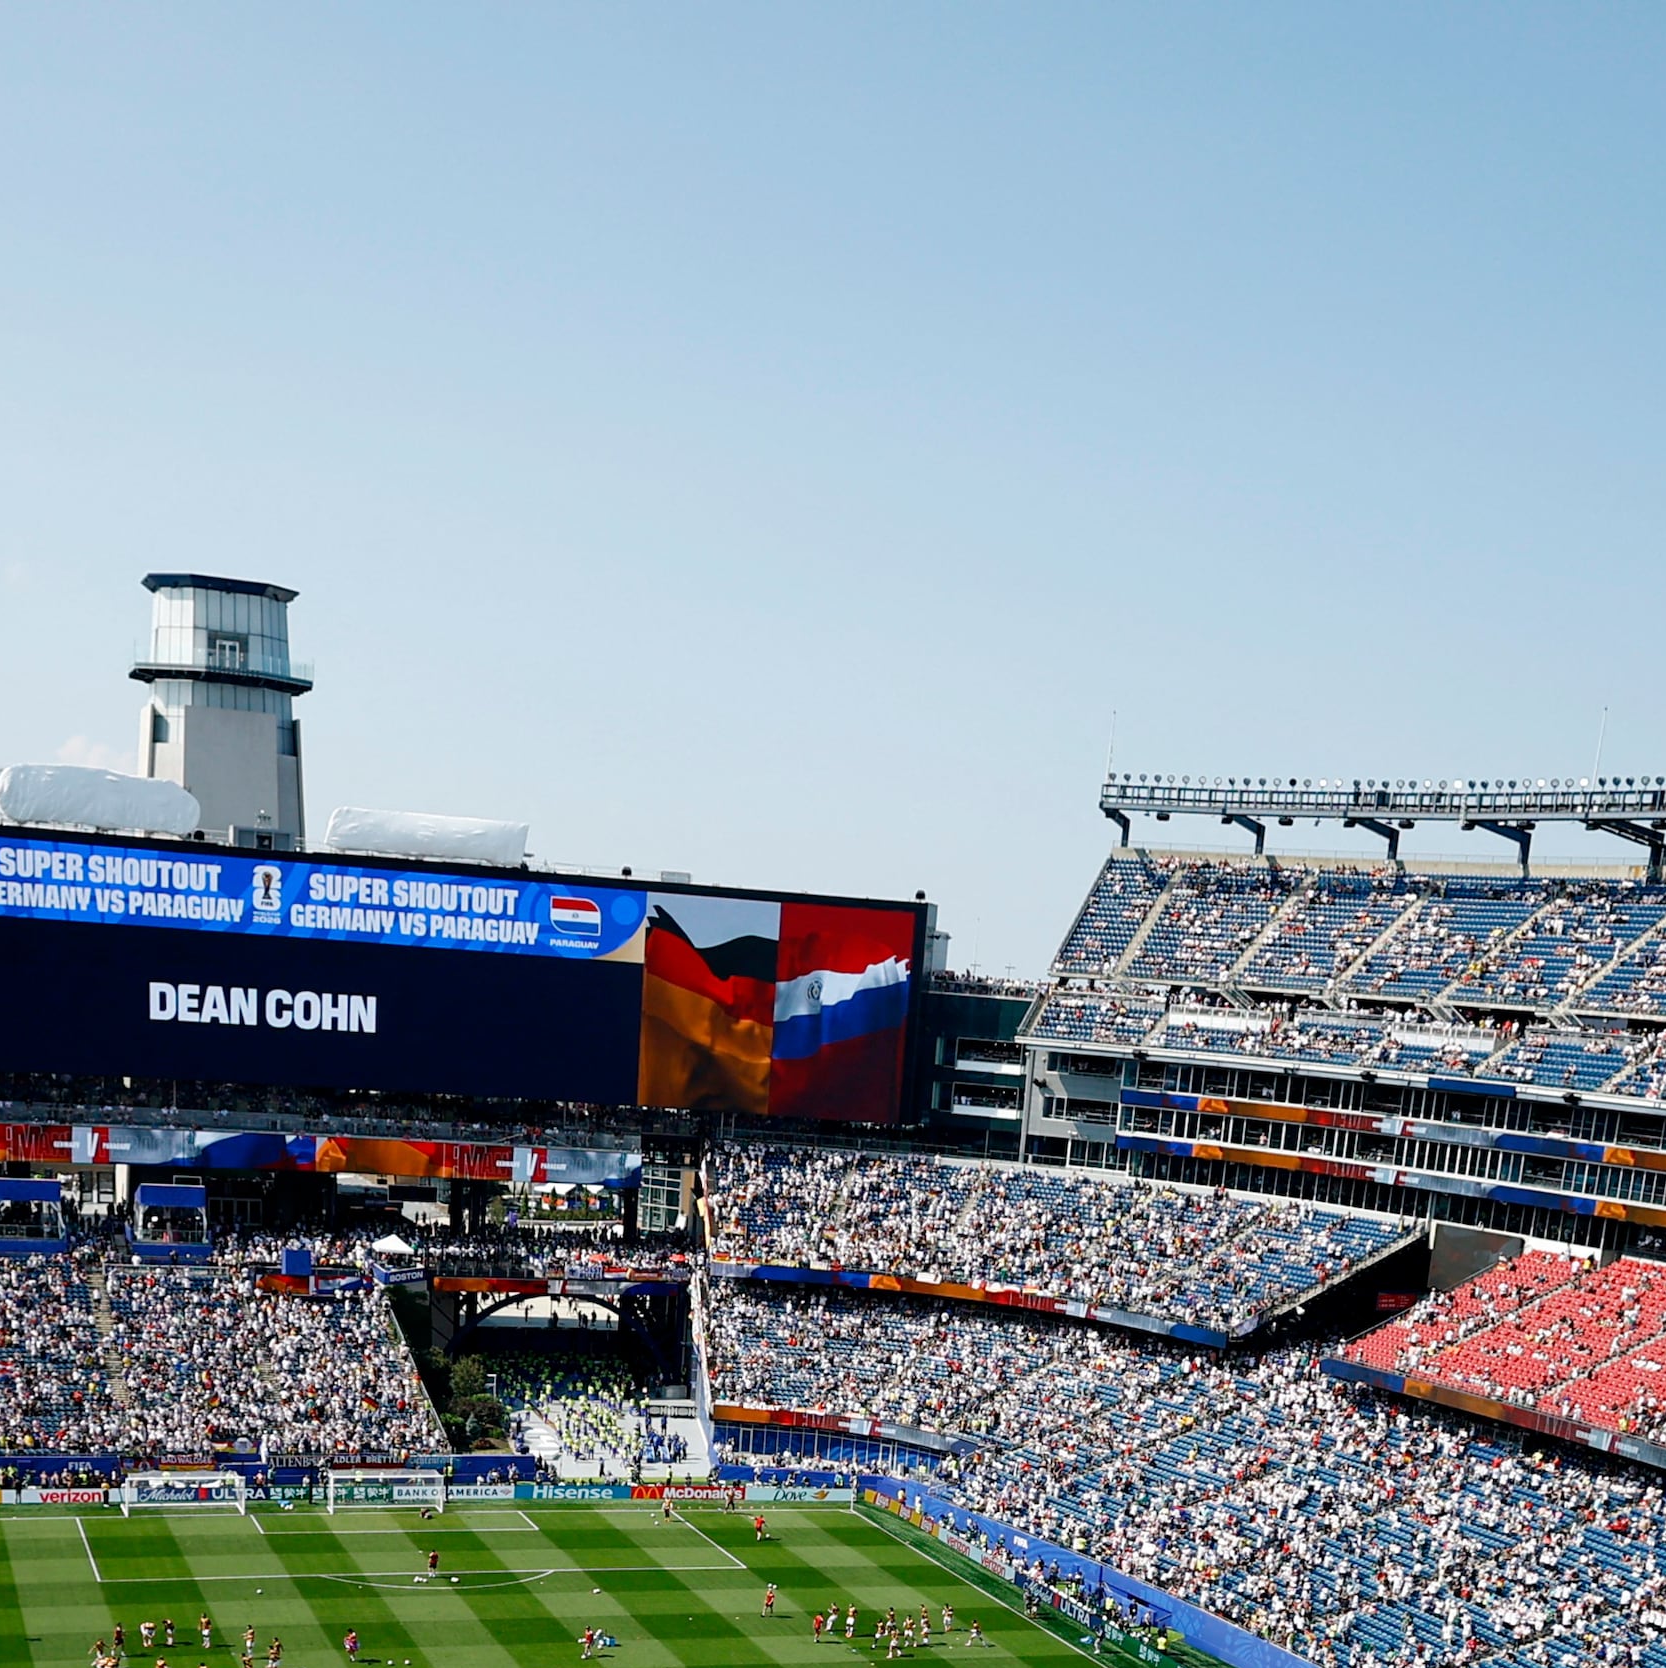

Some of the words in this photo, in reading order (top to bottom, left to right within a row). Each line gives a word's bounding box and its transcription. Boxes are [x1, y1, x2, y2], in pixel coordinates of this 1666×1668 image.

[88, 857, 221, 893] SHOUTOUT
[308, 873, 388, 906] SUPER
[392, 882, 519, 916] SHOUTOUT
[93, 887, 125, 914] VS
[128, 891, 244, 922] PARAGUAY
[252, 916, 282, 925] 2026
[290, 904, 396, 931] GERMANY
[398, 912, 426, 937] VS
[430, 916, 540, 945] PARAGUAY
[549, 938, 600, 950] PARAGUAY
[148, 982, 258, 1026] DEAN
[264, 988, 377, 1034] COHN
[389, 1270, 424, 1283] BOSTON
[68, 1461, 93, 1471] FIFA
[39, 1489, 102, 1503] verizon
[139, 1486, 196, 1502] Michelob
[212, 1487, 265, 1500] ULTRA
[397, 1488, 430, 1497] BANK
[448, 1487, 498, 1497] AMERICA
[533, 1486, 613, 1500] Hisense
[663, 1487, 743, 1500] McDonald's
[773, 1487, 807, 1501] Dove
[1059, 1598, 1091, 1628] ULTRA
